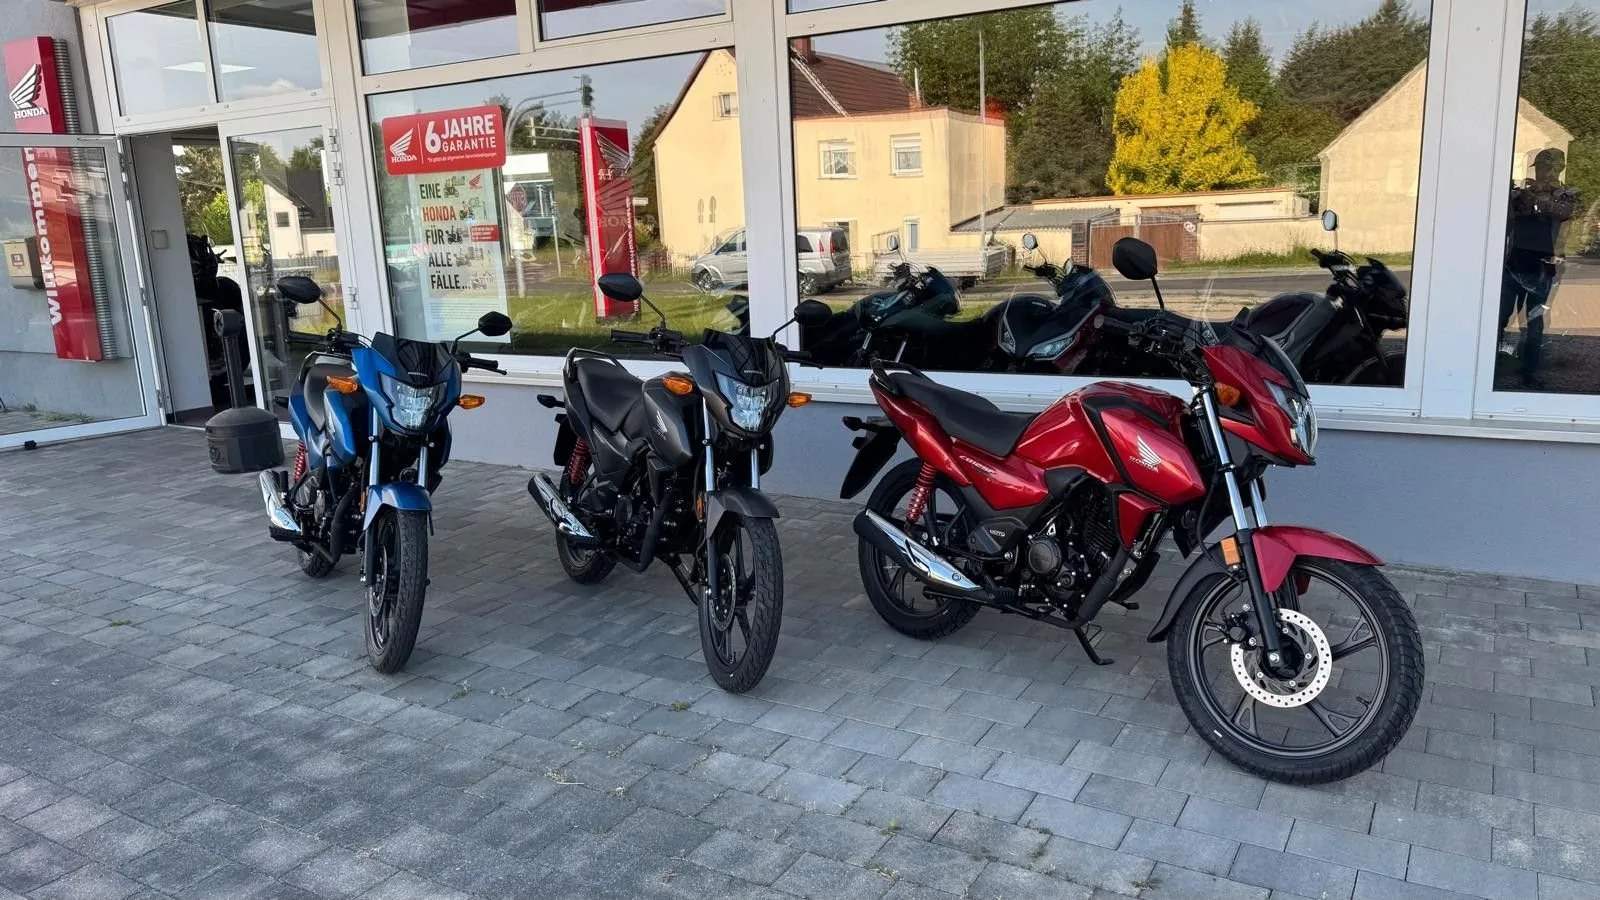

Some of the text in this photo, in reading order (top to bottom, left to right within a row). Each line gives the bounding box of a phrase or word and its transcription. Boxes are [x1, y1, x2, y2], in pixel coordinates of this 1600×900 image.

[14, 107, 47, 119] HONDA
[425, 121, 441, 154] 6
[442, 136, 497, 153] GARANTIE
[391, 154, 418, 164] HONDA
[419, 183, 442, 200] EINE
[422, 205, 457, 222] HONDA
[425, 224, 446, 245] FÜR
[428, 251, 453, 268] ALLE
